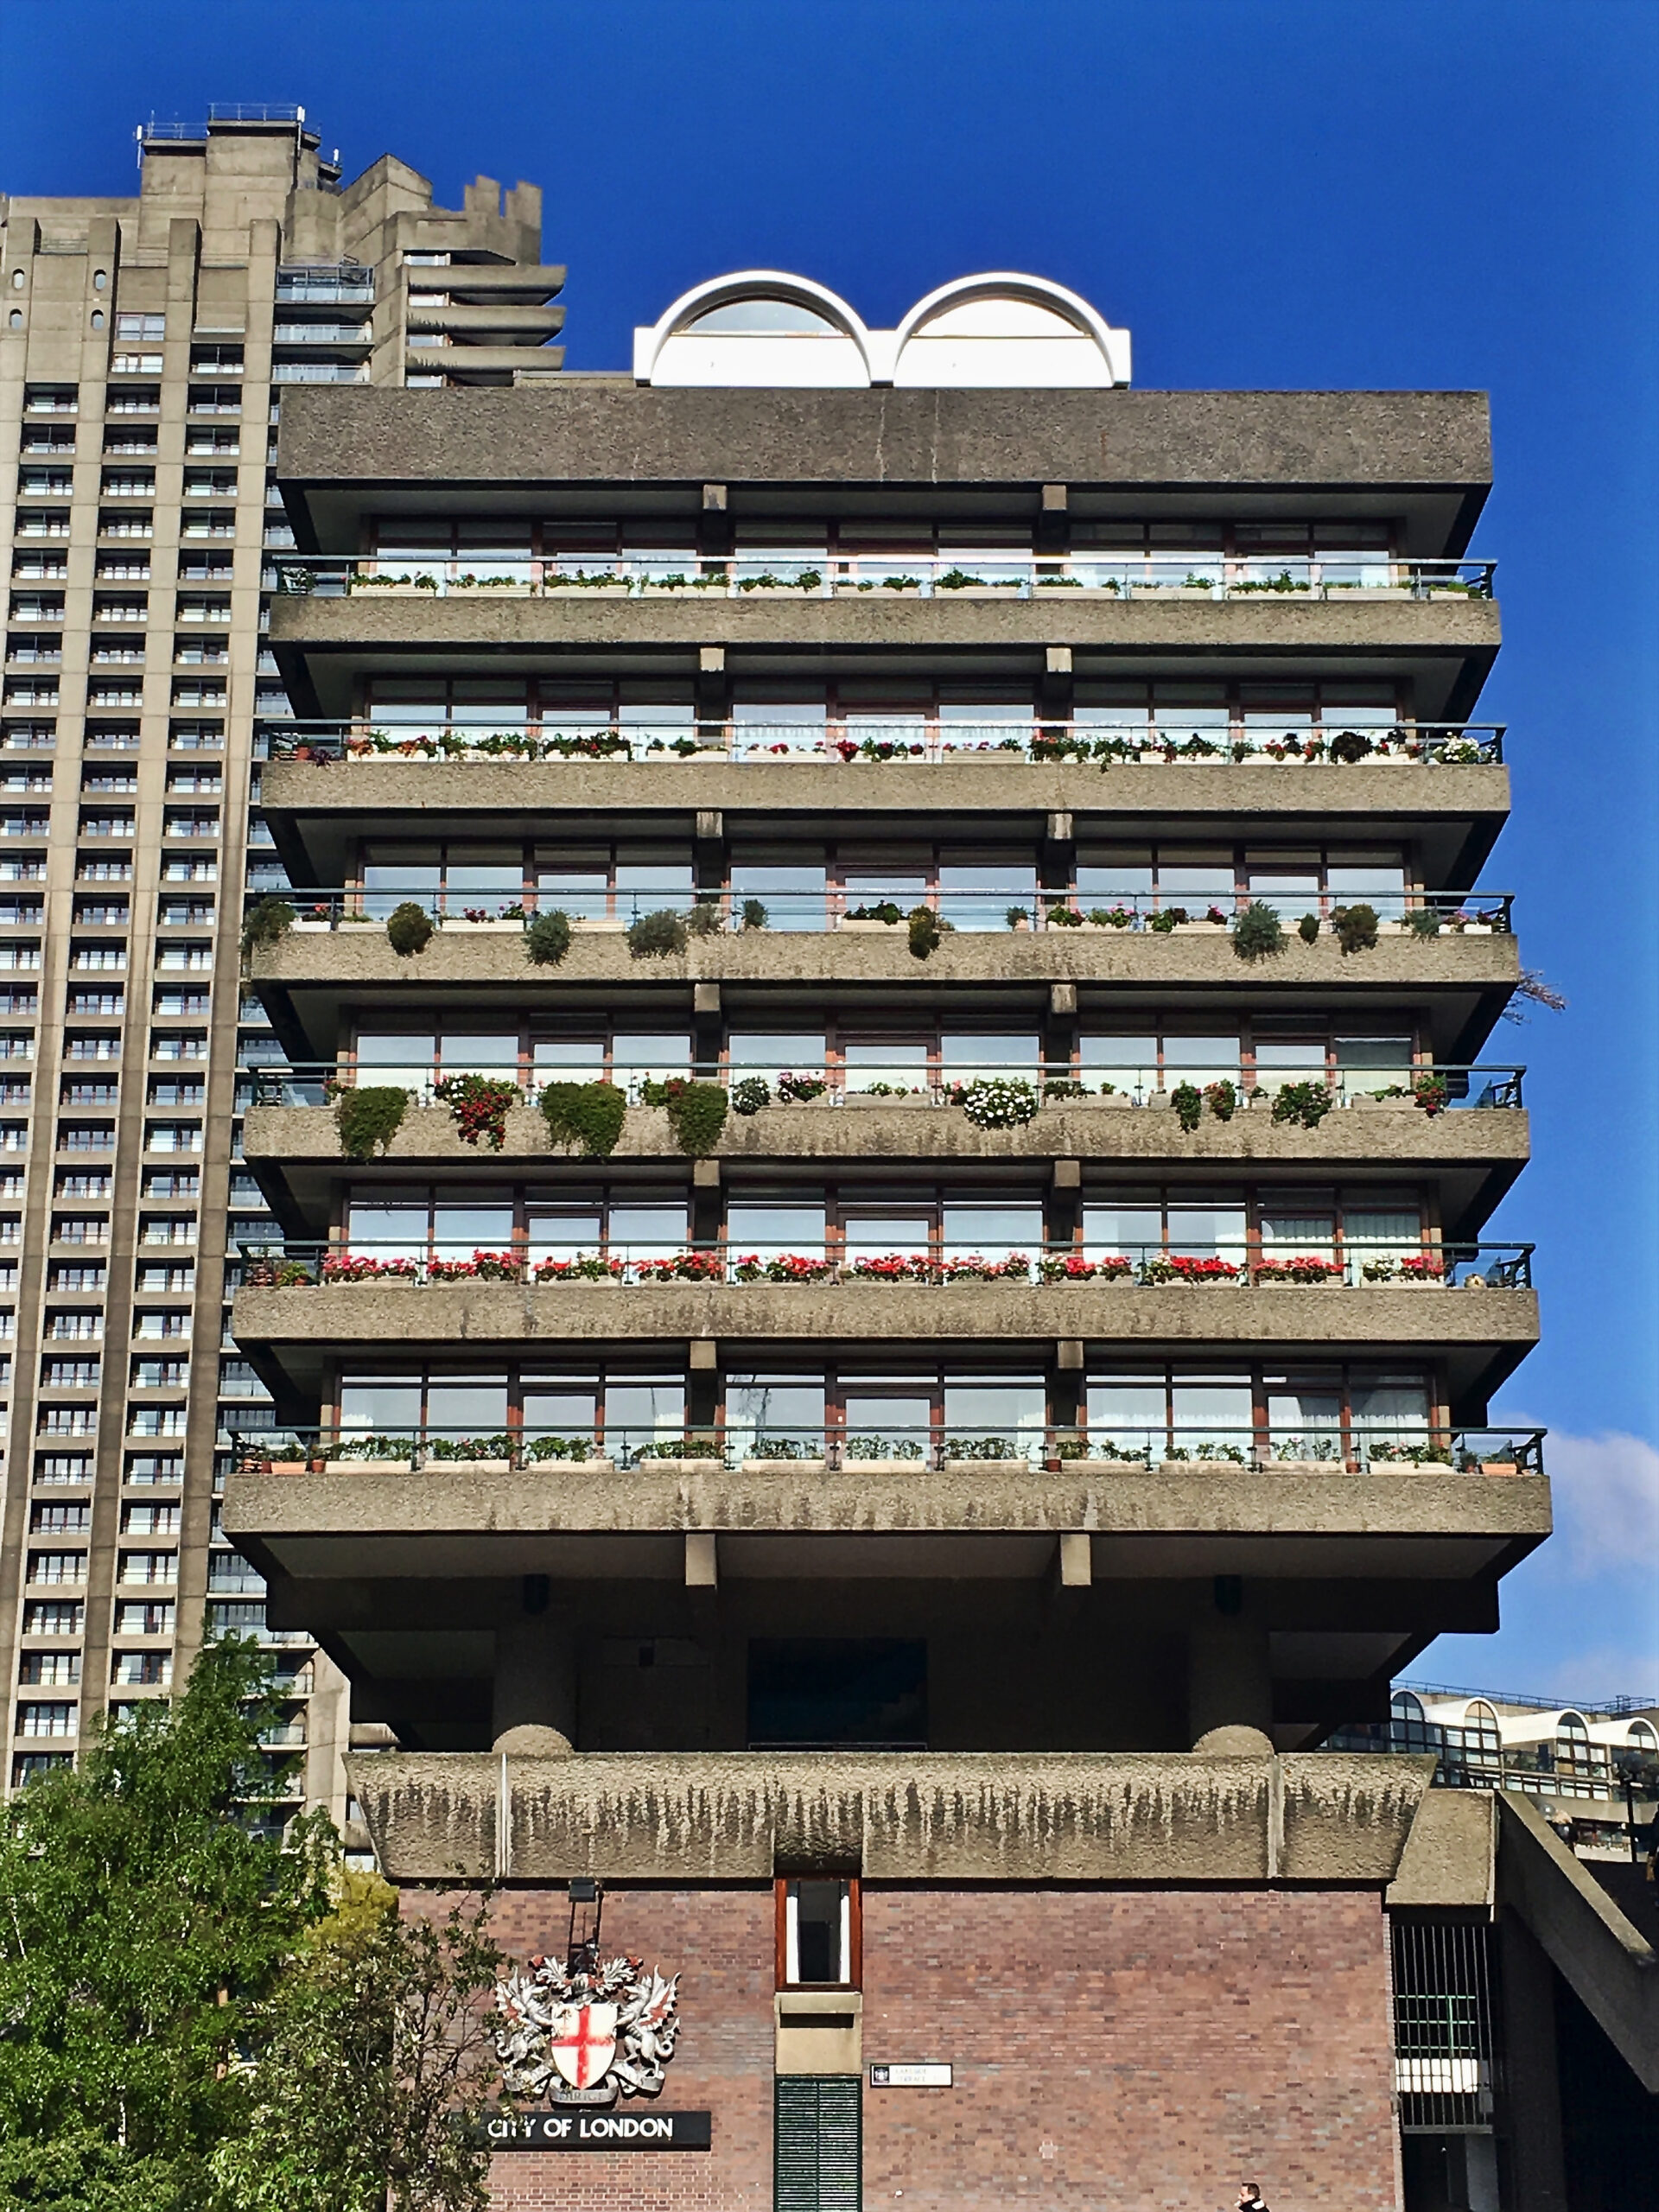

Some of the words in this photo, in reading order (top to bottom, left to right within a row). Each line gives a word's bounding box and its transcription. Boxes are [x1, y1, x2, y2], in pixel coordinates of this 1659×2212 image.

[487, 2118, 536, 2138] CITY
[543, 2118, 573, 2138] OF
[580, 2118, 673, 2138] LONDON
